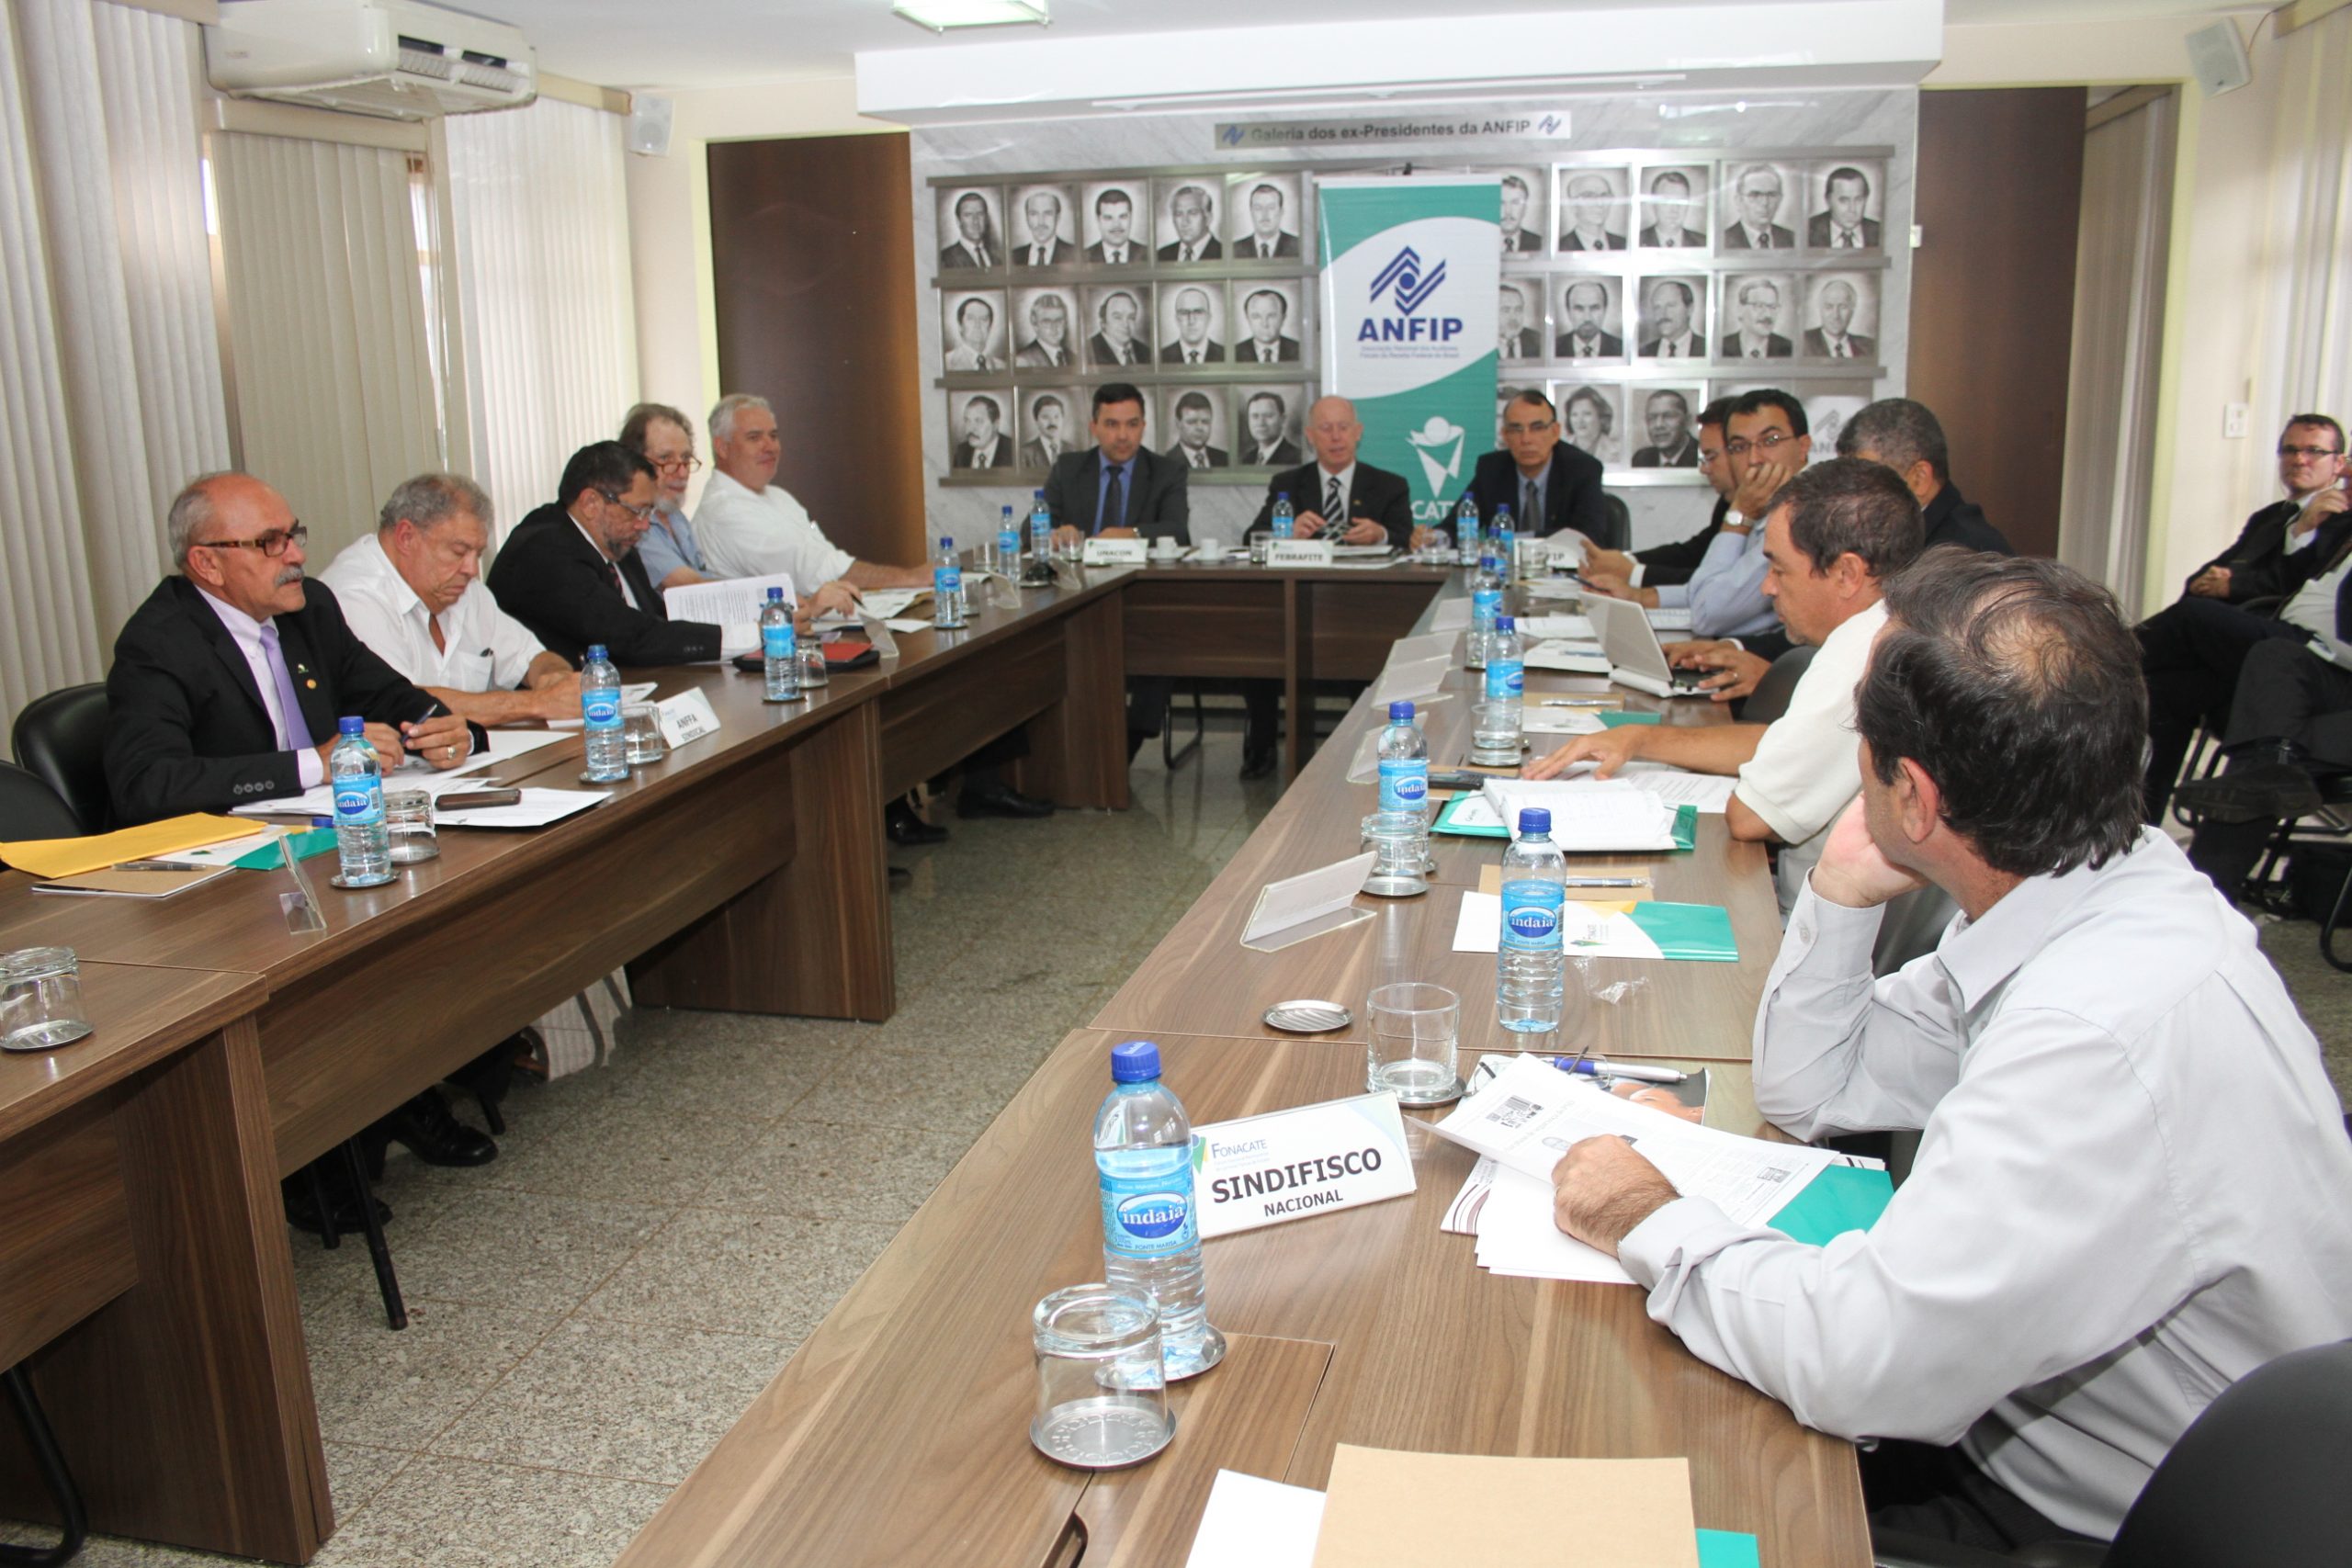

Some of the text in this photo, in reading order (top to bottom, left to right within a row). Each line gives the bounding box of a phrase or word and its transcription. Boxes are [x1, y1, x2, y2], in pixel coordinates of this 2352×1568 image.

[1250, 119, 1532, 141] Galeria dos ex-Presidentes da ANFIP
[1357, 318, 1463, 341] ANFIP
[1212, 1148, 1382, 1203] SINDIFISCO
[1264, 1190, 1343, 1217] NACIONAL
